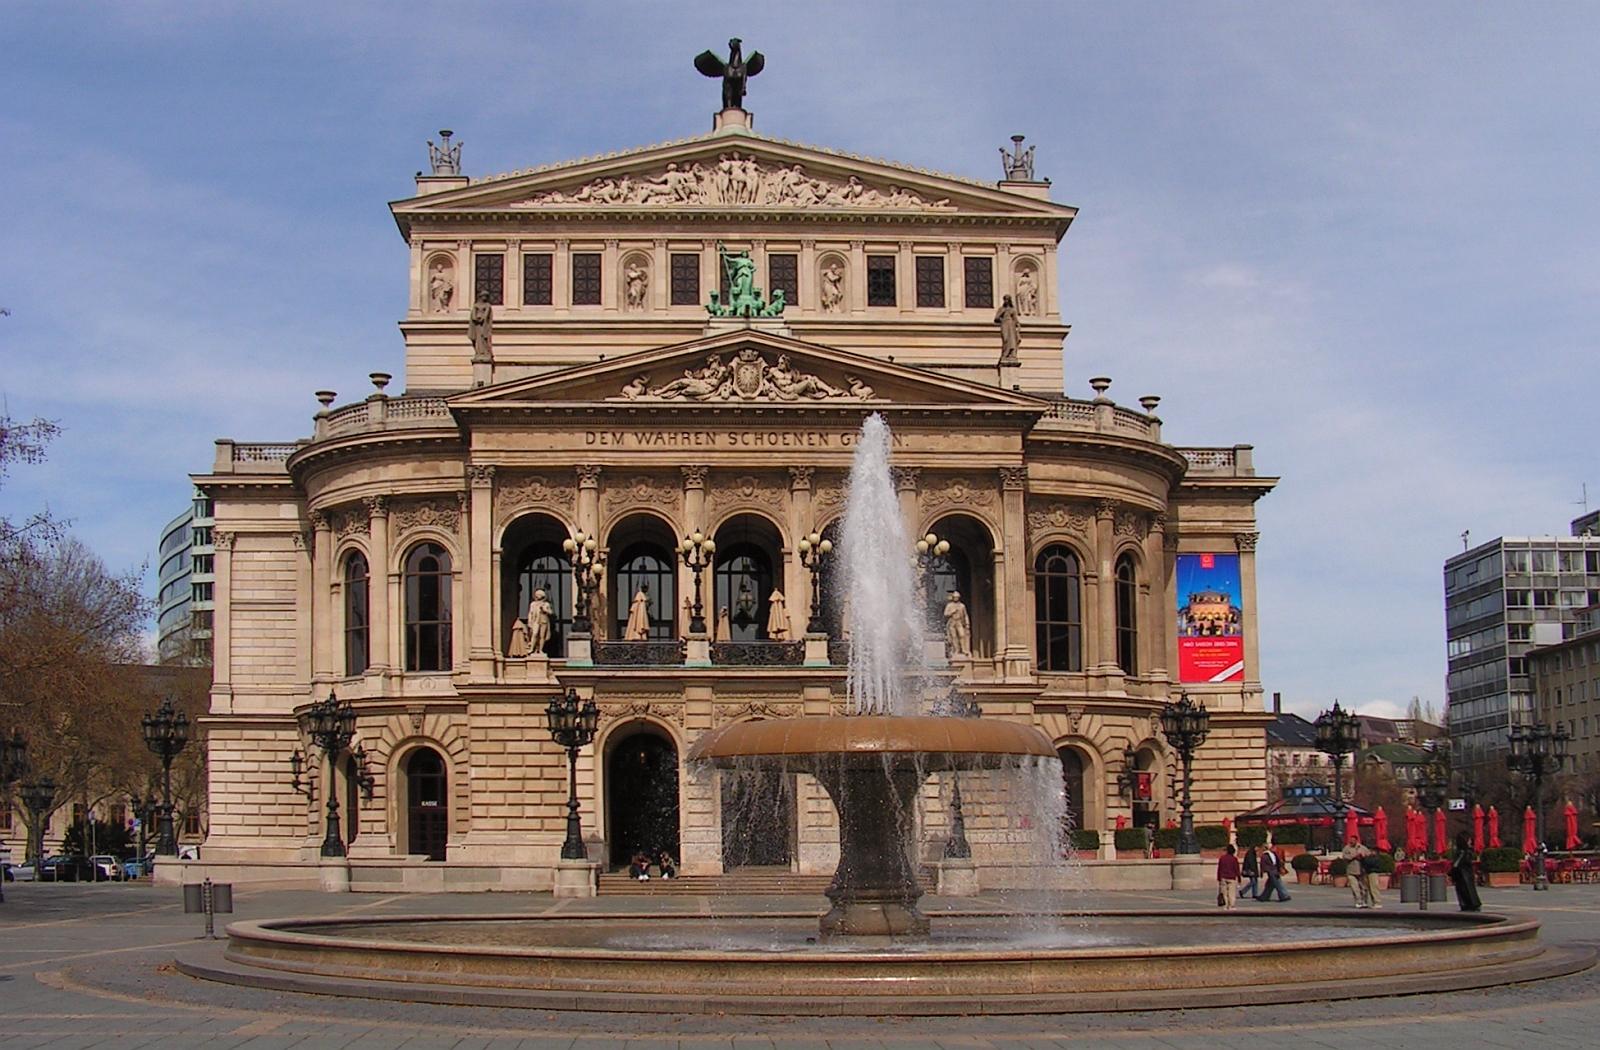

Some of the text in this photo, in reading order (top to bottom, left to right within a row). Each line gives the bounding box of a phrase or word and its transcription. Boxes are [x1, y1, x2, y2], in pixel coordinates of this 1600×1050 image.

[585, 431, 625, 446] DEM
[632, 431, 717, 446] WAHREN
[727, 431, 830, 446] SCHOENEN
